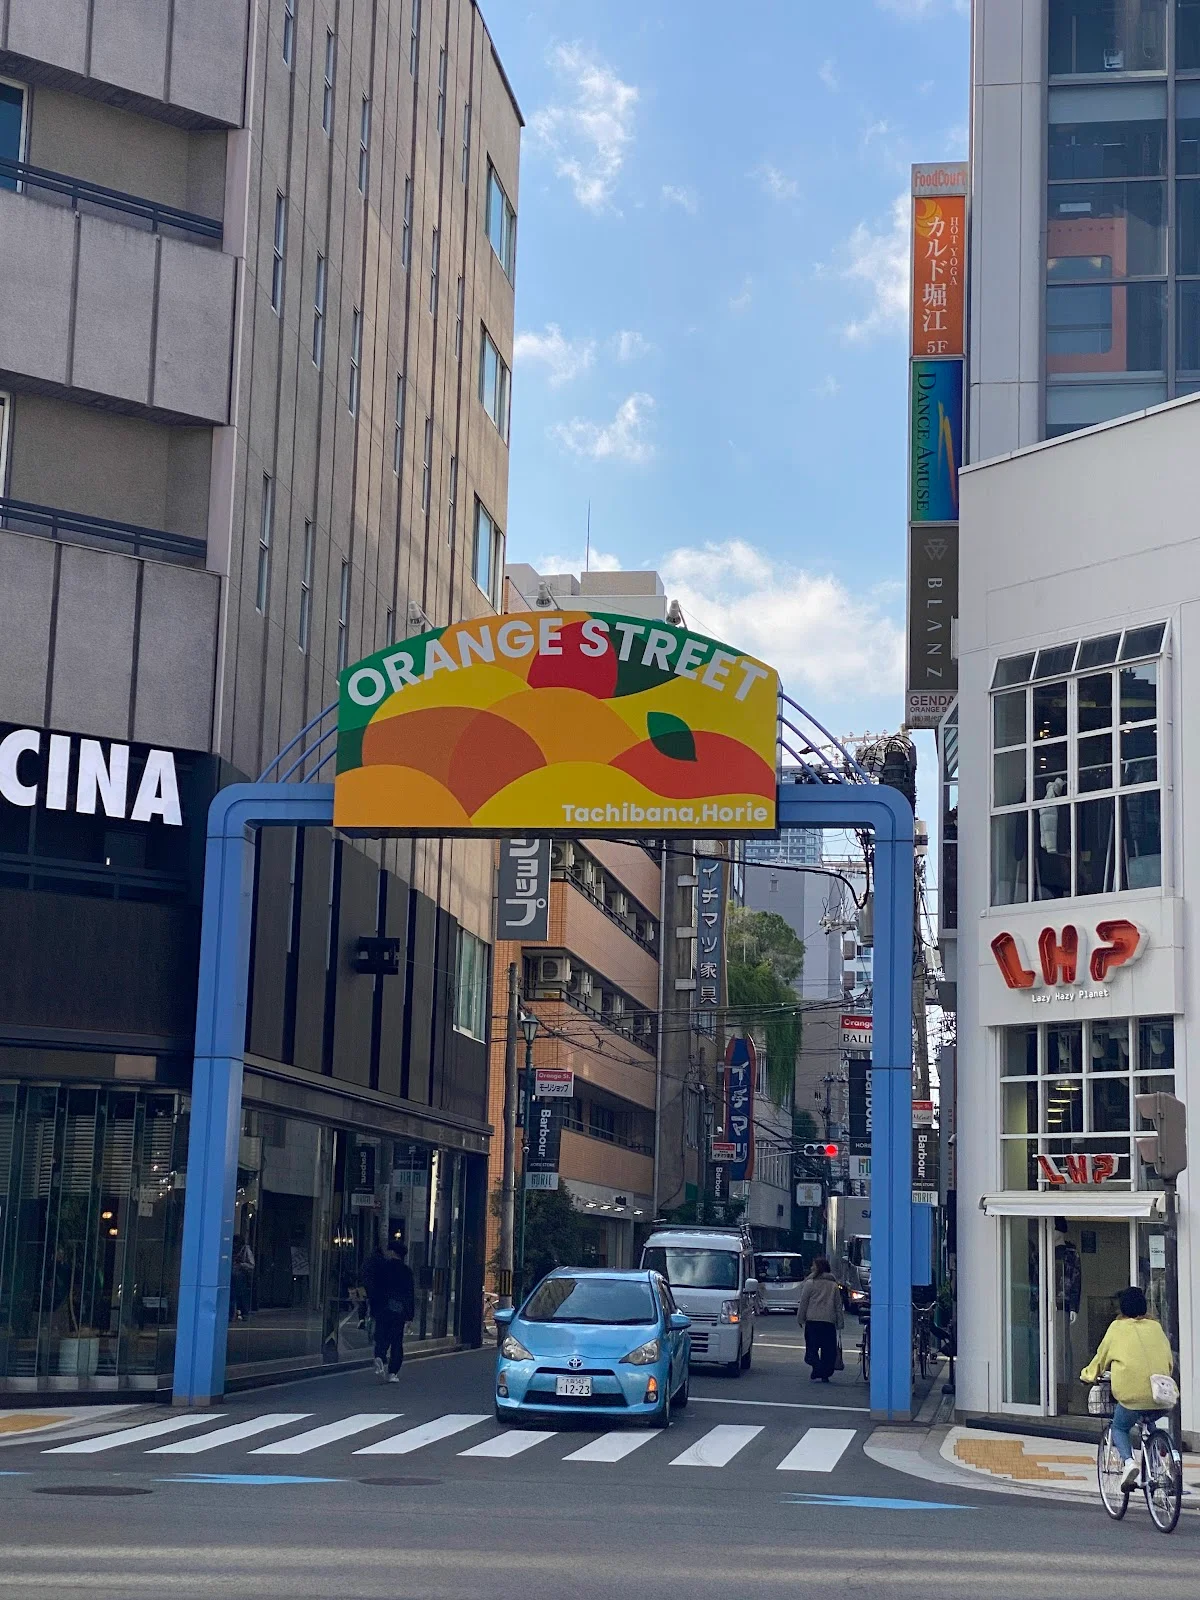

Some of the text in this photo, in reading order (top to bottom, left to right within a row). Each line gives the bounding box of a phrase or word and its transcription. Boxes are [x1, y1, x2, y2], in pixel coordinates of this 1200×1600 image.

[922, 216, 948, 332] カルド堀江
[949, 217, 959, 286] HOT YOGA
[926, 340, 948, 354] 5F
[917, 372, 936, 511] DANCE AMUSE
[347, 617, 769, 706] ORANGE STREET
[0, 729, 183, 827] CINA
[700, 862, 719, 1004] イチマツ家具
[990, 919, 1146, 989] LHP
[1031, 988, 1109, 1004] Lazy Hazy Planet
[538, 1109, 552, 1157] Barbour
[918, 1134, 928, 1178] Barbour
[715, 1166, 723, 1197] Barbour
[1037, 1153, 1118, 1185] LHP
[565, 1384, 590, 1395] 12-23
